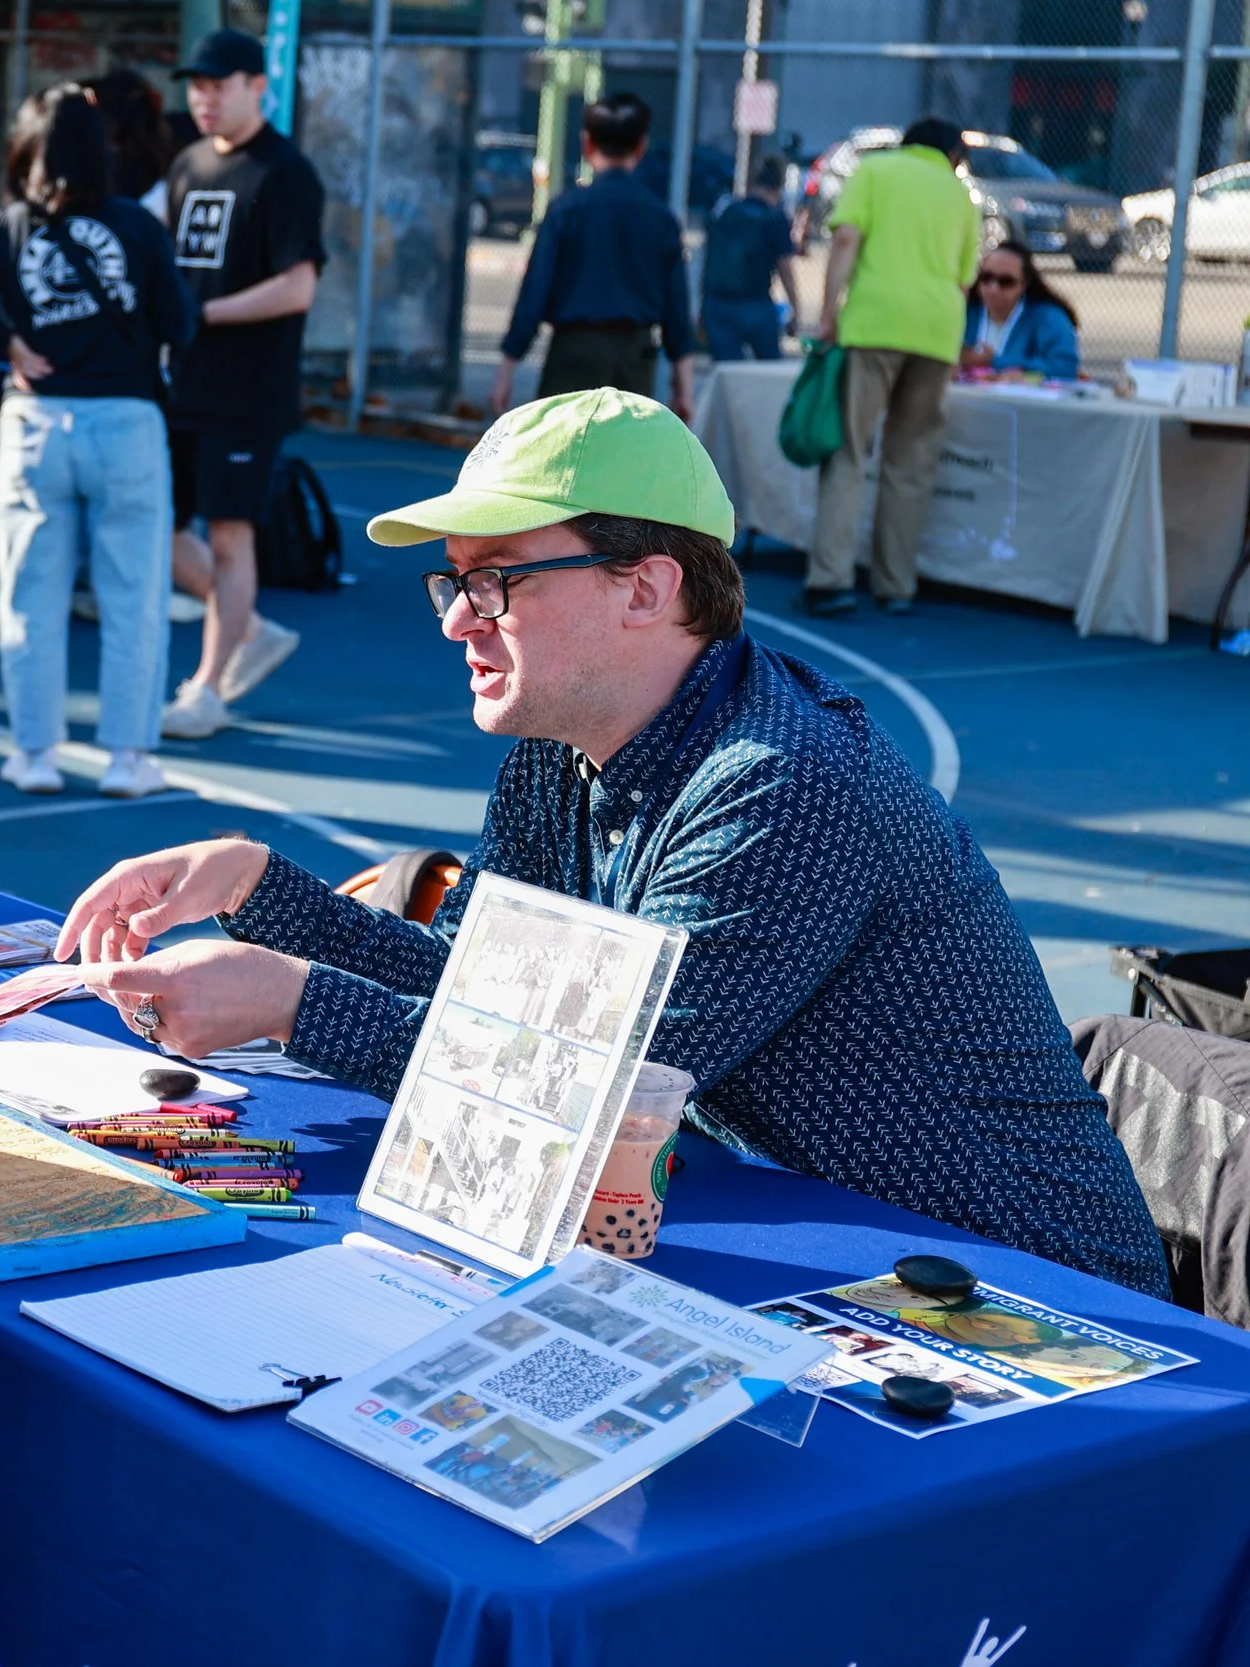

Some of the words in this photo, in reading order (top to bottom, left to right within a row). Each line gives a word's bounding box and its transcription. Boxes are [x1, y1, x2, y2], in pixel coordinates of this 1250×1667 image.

[665, 1298, 727, 1333] Angel
[725, 1320, 792, 1355] Island
[839, 1307, 889, 1327] ADD
[892, 1322, 954, 1354] YOUR
[953, 1348, 1033, 1380] STORY
[971, 1286, 1076, 1331] MIGRANT
[1075, 1325, 1164, 1361] VOICES
